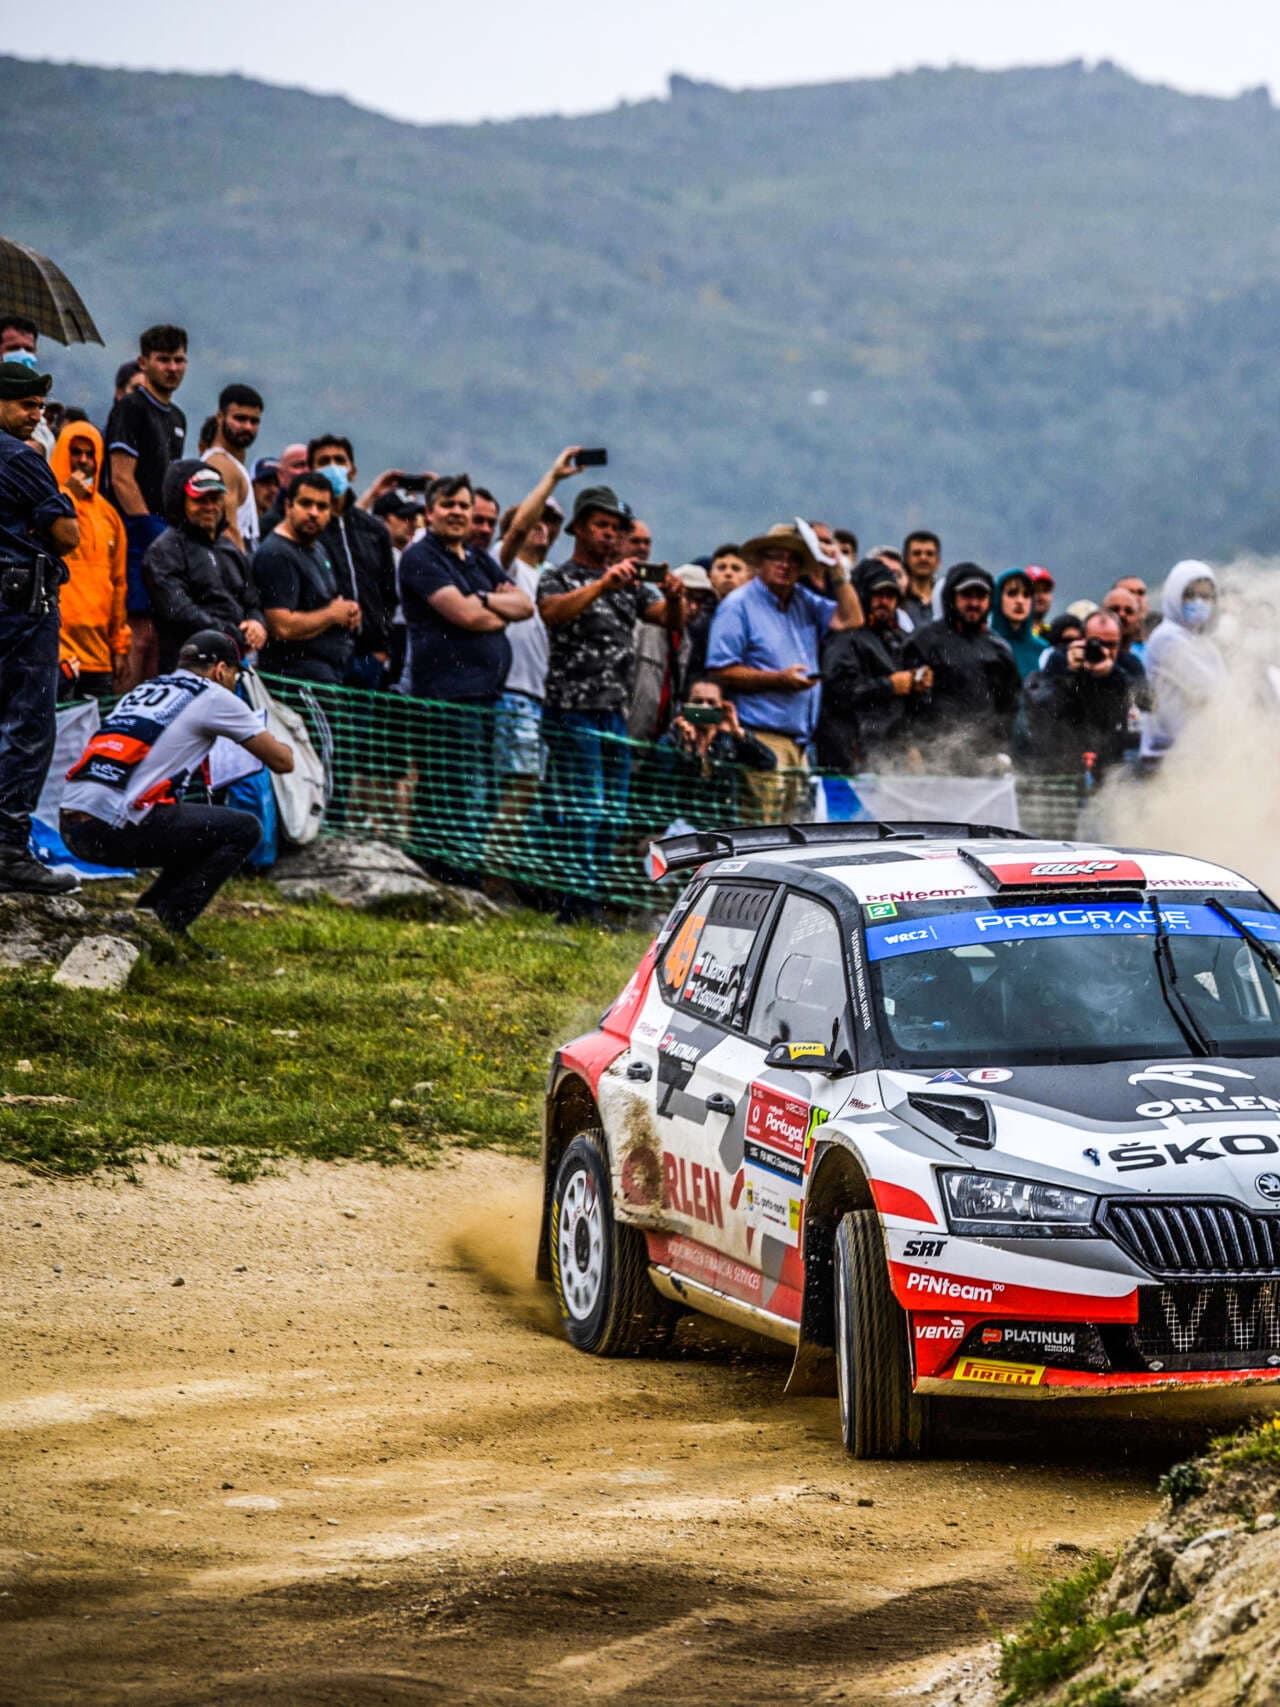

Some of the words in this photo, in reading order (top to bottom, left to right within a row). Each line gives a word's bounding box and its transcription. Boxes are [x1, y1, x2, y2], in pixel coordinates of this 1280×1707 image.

[884, 930, 929, 945] WRC2
[981, 1071, 999, 1080] E
[765, 1112, 804, 1142] Portugal
[903, 1240, 948, 1257] SRT
[906, 1272, 993, 1303] PFNteam
[915, 1324, 966, 1340] verva
[1004, 1328, 1076, 1346] PLATINUM
[963, 1361, 1037, 1385] PIRELLI
